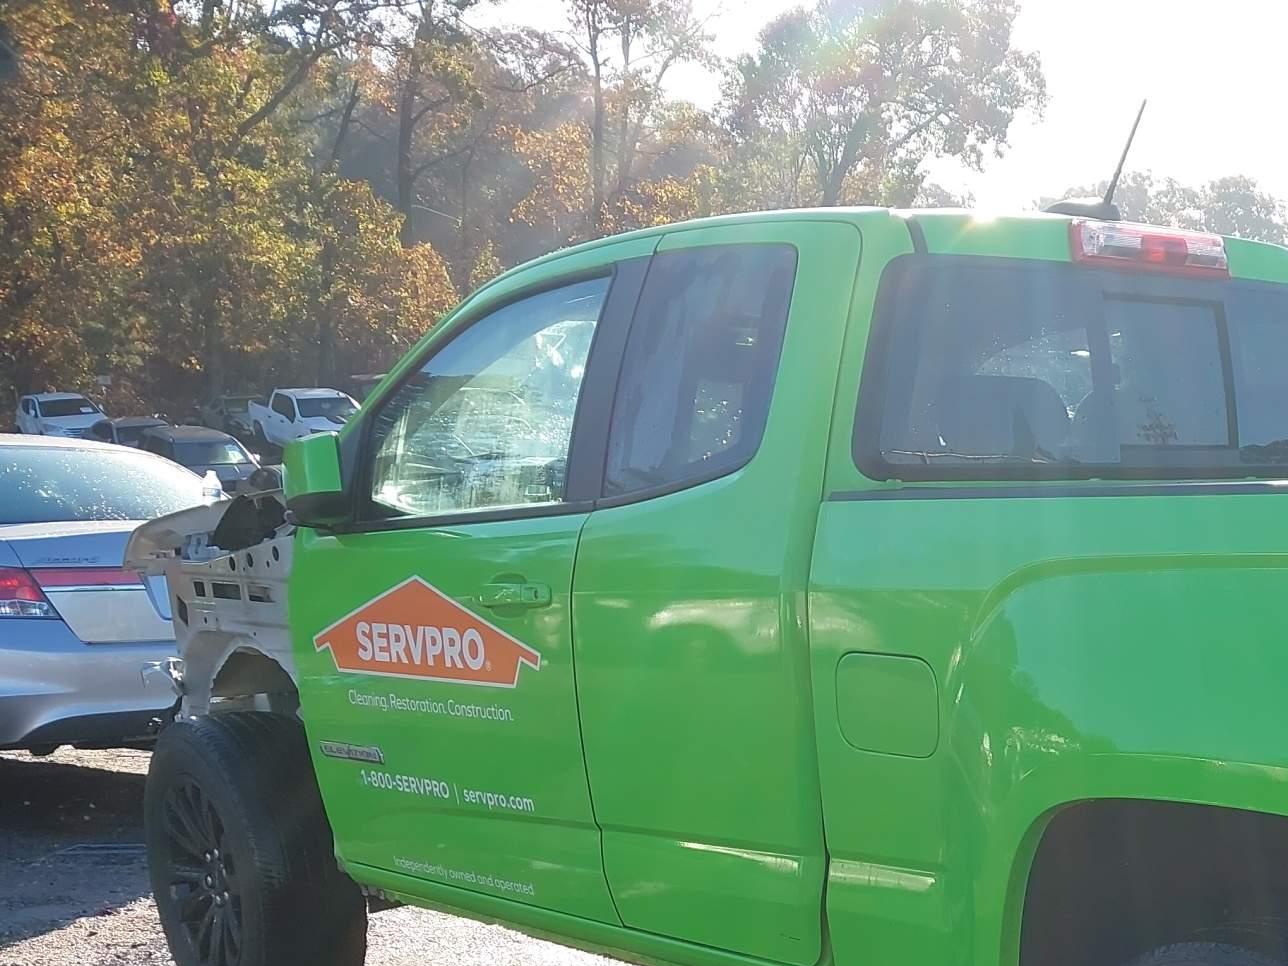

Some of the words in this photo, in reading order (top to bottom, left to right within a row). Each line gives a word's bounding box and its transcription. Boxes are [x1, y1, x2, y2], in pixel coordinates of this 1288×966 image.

[355, 620, 485, 671] SERVPRO
[360, 768, 449, 799] 1-800-SERVPRO
[463, 788, 535, 813] servpro.com
[393, 855, 448, 879] Independently
[448, 868, 476, 883] owned
[477, 873, 494, 887] and
[494, 879, 535, 896] operated
